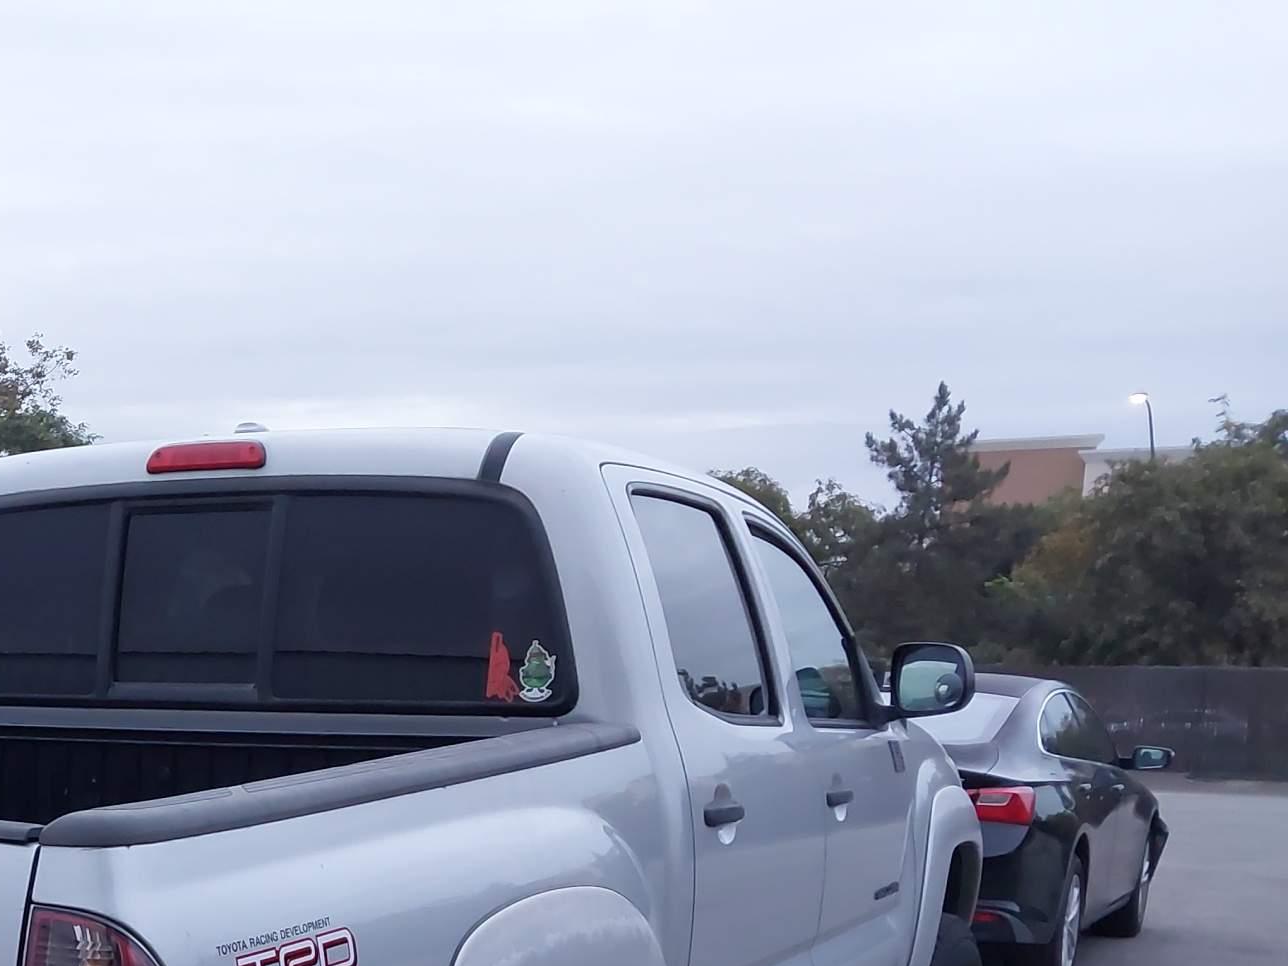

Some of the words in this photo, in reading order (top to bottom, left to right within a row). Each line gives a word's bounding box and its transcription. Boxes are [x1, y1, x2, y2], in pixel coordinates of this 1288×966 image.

[216, 941, 249, 957] TOYOTA
[248, 931, 279, 948] RACING
[280, 917, 330, 940] DEVELOPMENT
